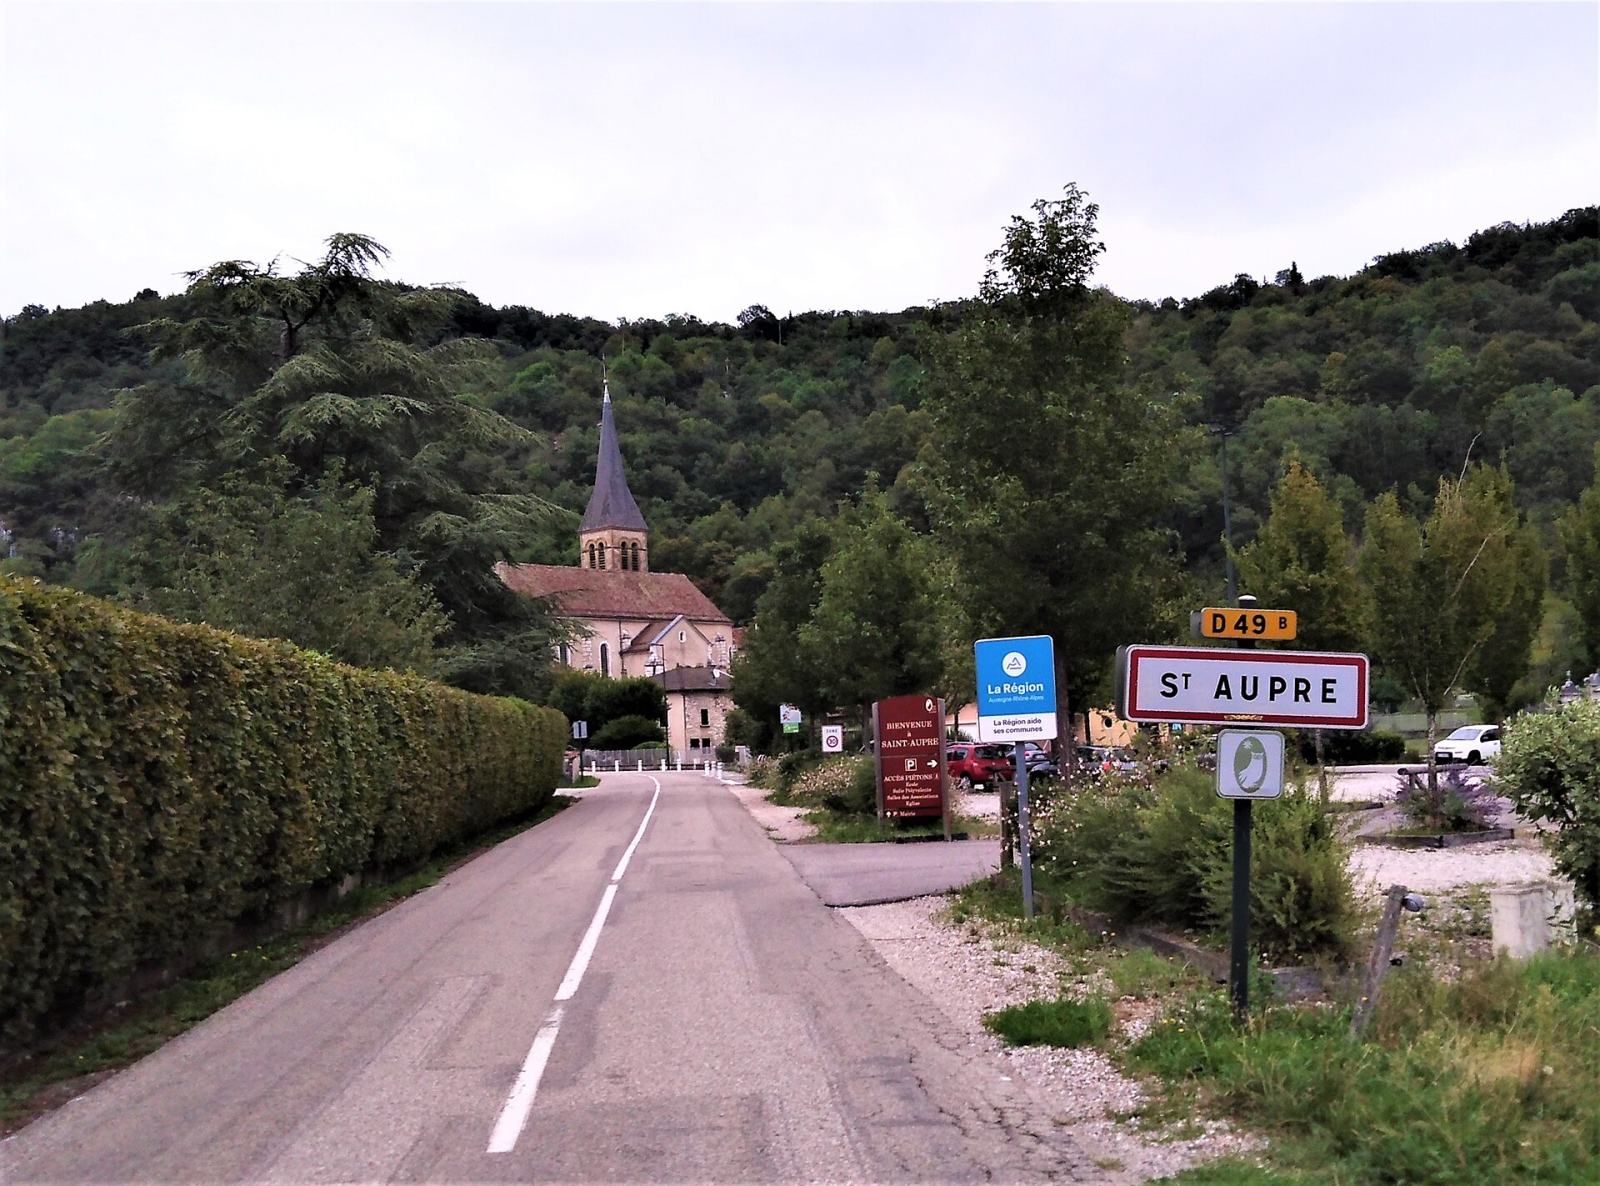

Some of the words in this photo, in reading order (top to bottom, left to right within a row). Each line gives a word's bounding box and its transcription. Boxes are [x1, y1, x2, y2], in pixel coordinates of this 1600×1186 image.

[1212, 613, 1226, 633] D
[1234, 614, 1266, 635] 49
[1278, 616, 1288, 630] B
[988, 684, 1001, 695] La
[1003, 682, 1044, 695] Région
[1214, 674, 1337, 704] AUPRE
[886, 720, 933, 730] BIENVENUE
[1002, 718, 1026, 726] Région
[1027, 717, 1042, 725] aide
[1005, 726, 1043, 734] communes
[881, 738, 939, 748] SAINT-AUPRE
